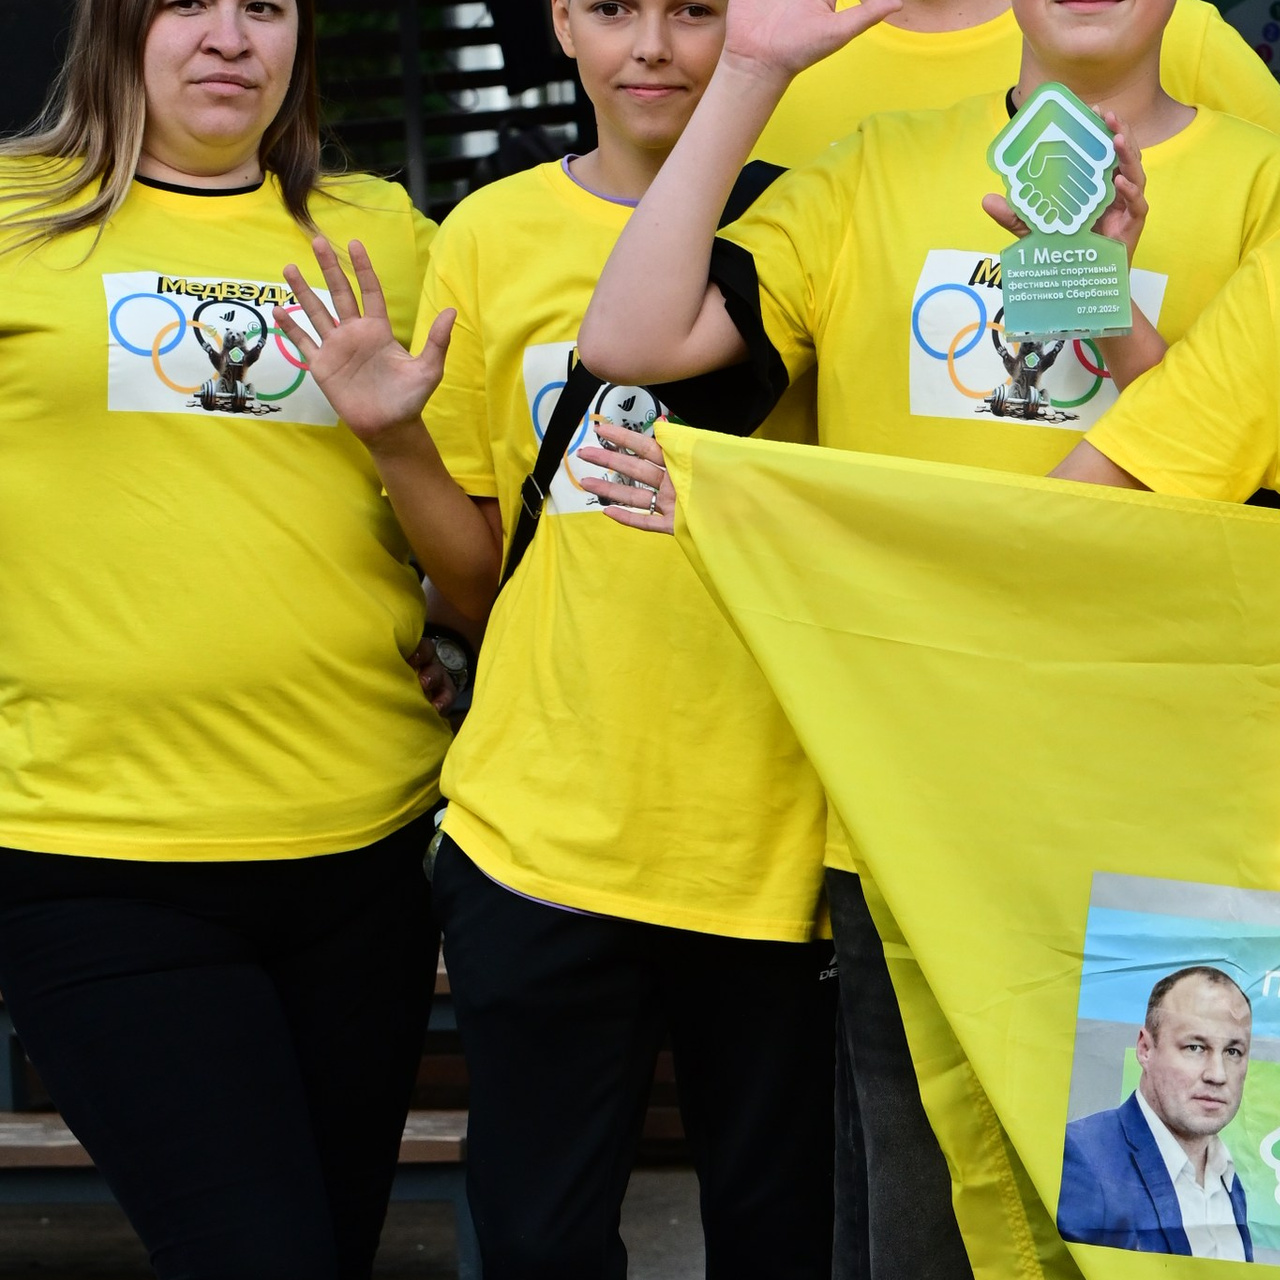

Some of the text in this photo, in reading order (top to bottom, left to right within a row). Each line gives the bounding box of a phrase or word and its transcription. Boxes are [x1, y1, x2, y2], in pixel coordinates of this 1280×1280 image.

[1018, 247, 1098, 265] 1 Место
[1007, 266, 1059, 278] Ежегодный
[1060, 263, 1117, 276] спортивный
[1008, 277, 1118, 291] фестиваль профсоюза
[1008, 288, 1120, 303] работников Сбербанка
[1077, 305, 1120, 315] 07.09.2025г
